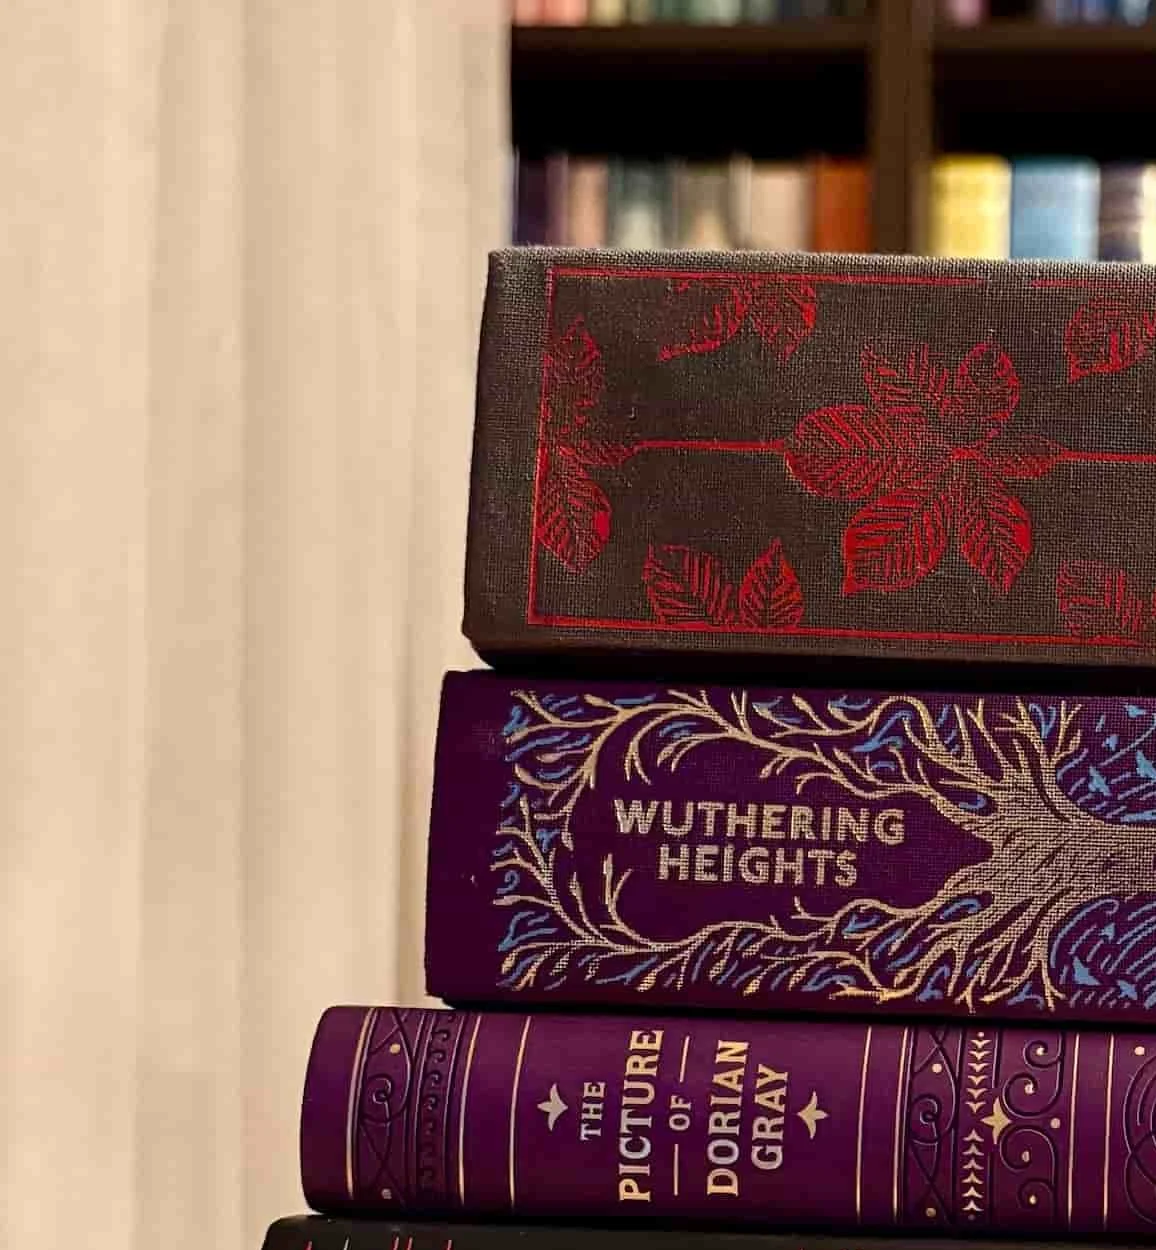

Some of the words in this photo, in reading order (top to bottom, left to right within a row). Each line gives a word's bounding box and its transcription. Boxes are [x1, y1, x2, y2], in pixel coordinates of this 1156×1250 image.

[614, 798, 905, 845] WUTHERING
[656, 844, 857, 888] HEIGHTS
[580, 1081, 606, 1141] THE
[618, 1030, 664, 1202] PICTURE
[668, 1095, 692, 1131] OF
[707, 1040, 749, 1196] DORIAN
[751, 1064, 788, 1170] GRAY
